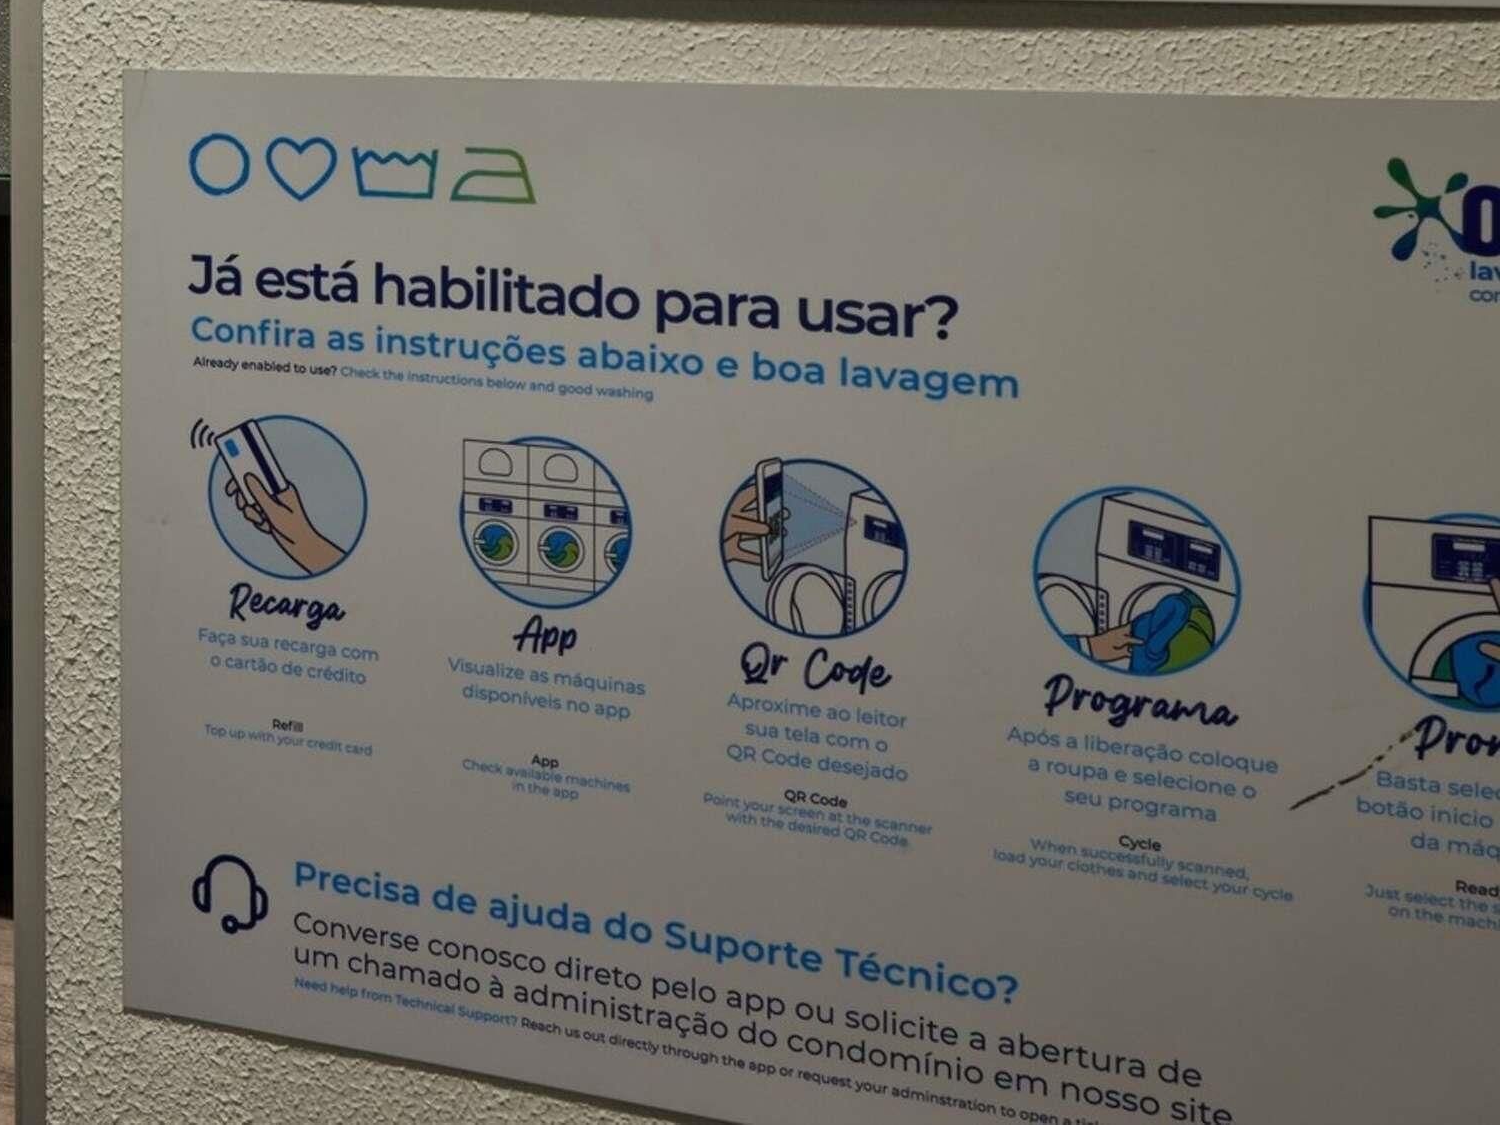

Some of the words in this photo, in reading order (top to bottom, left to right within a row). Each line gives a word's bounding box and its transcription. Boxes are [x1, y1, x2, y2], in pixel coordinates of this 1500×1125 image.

[188, 254, 242, 296] Já
[255, 263, 358, 303] está
[375, 262, 640, 320] habilitado
[656, 289, 779, 334] para
[798, 294, 959, 340] usar?
[191, 315, 315, 349] Confira
[327, 330, 365, 352] as
[376, 325, 567, 370] instruções
[578, 341, 704, 376] abaixo
[716, 356, 739, 379] e
[753, 351, 825, 385] boa
[840, 357, 1019, 401] lavagem
[229, 582, 346, 630] Recarga
[198, 627, 237, 648] Faça
[240, 634, 270, 649] sua
[274, 638, 337, 659] recarga
[340, 646, 379, 661] com
[514, 615, 578, 656] App
[210, 655, 221, 668] o
[224, 656, 278, 674] cartão
[281, 660, 304, 677] de
[306, 666, 367, 685] crédito
[448, 657, 525, 681] Visualize
[529, 670, 550, 684] as
[553, 672, 646, 696] máquinas
[741, 641, 787, 685] Qr
[804, 647, 892, 695] Code
[461, 683, 562, 711] disponíveis
[566, 699, 590, 714] no
[594, 703, 631, 722] app
[726, 693, 822, 718] Aproxime
[826, 707, 851, 722] ao
[856, 708, 907, 729] leitor
[1044, 673, 1238, 727] Programa
[745, 723, 779, 739] sua
[784, 726, 820, 744] tela
[825, 733, 870, 750] com
[875, 739, 888, 753] o
[726, 746, 756, 763] QR
[761, 750, 812, 770] Code
[817, 757, 908, 782] desejado
[295, 861, 420, 907] Precisa
[432, 883, 478, 915] de
[489, 893, 592, 935] ajuda
[604, 911, 653, 944] do
[665, 921, 823, 973] Suporte
[835, 948, 1019, 1004] Técnico?
[293, 911, 420, 952] Converse
[427, 938, 546, 974] conosco
[554, 956, 642, 991] direto
[652, 976, 717, 1004] pelo
[726, 989, 786, 1020] app
[795, 1001, 834, 1025] ou
[845, 1009, 959, 1046] solicite
[969, 1031, 986, 1052] a
[998, 1032, 1146, 1079] abertura
[1157, 1059, 1202, 1088] de
[294, 946, 339, 970] um
[347, 952, 480, 994] chamado
[489, 974, 504, 999] à
[513, 984, 729, 1039] administração
[738, 1020, 778, 1048] do
[786, 1034, 984, 1085] condomínio
[994, 1070, 1048, 1097] em
[1061, 1081, 1160, 1116] nosso
[1170, 1097, 1232, 1125] site
